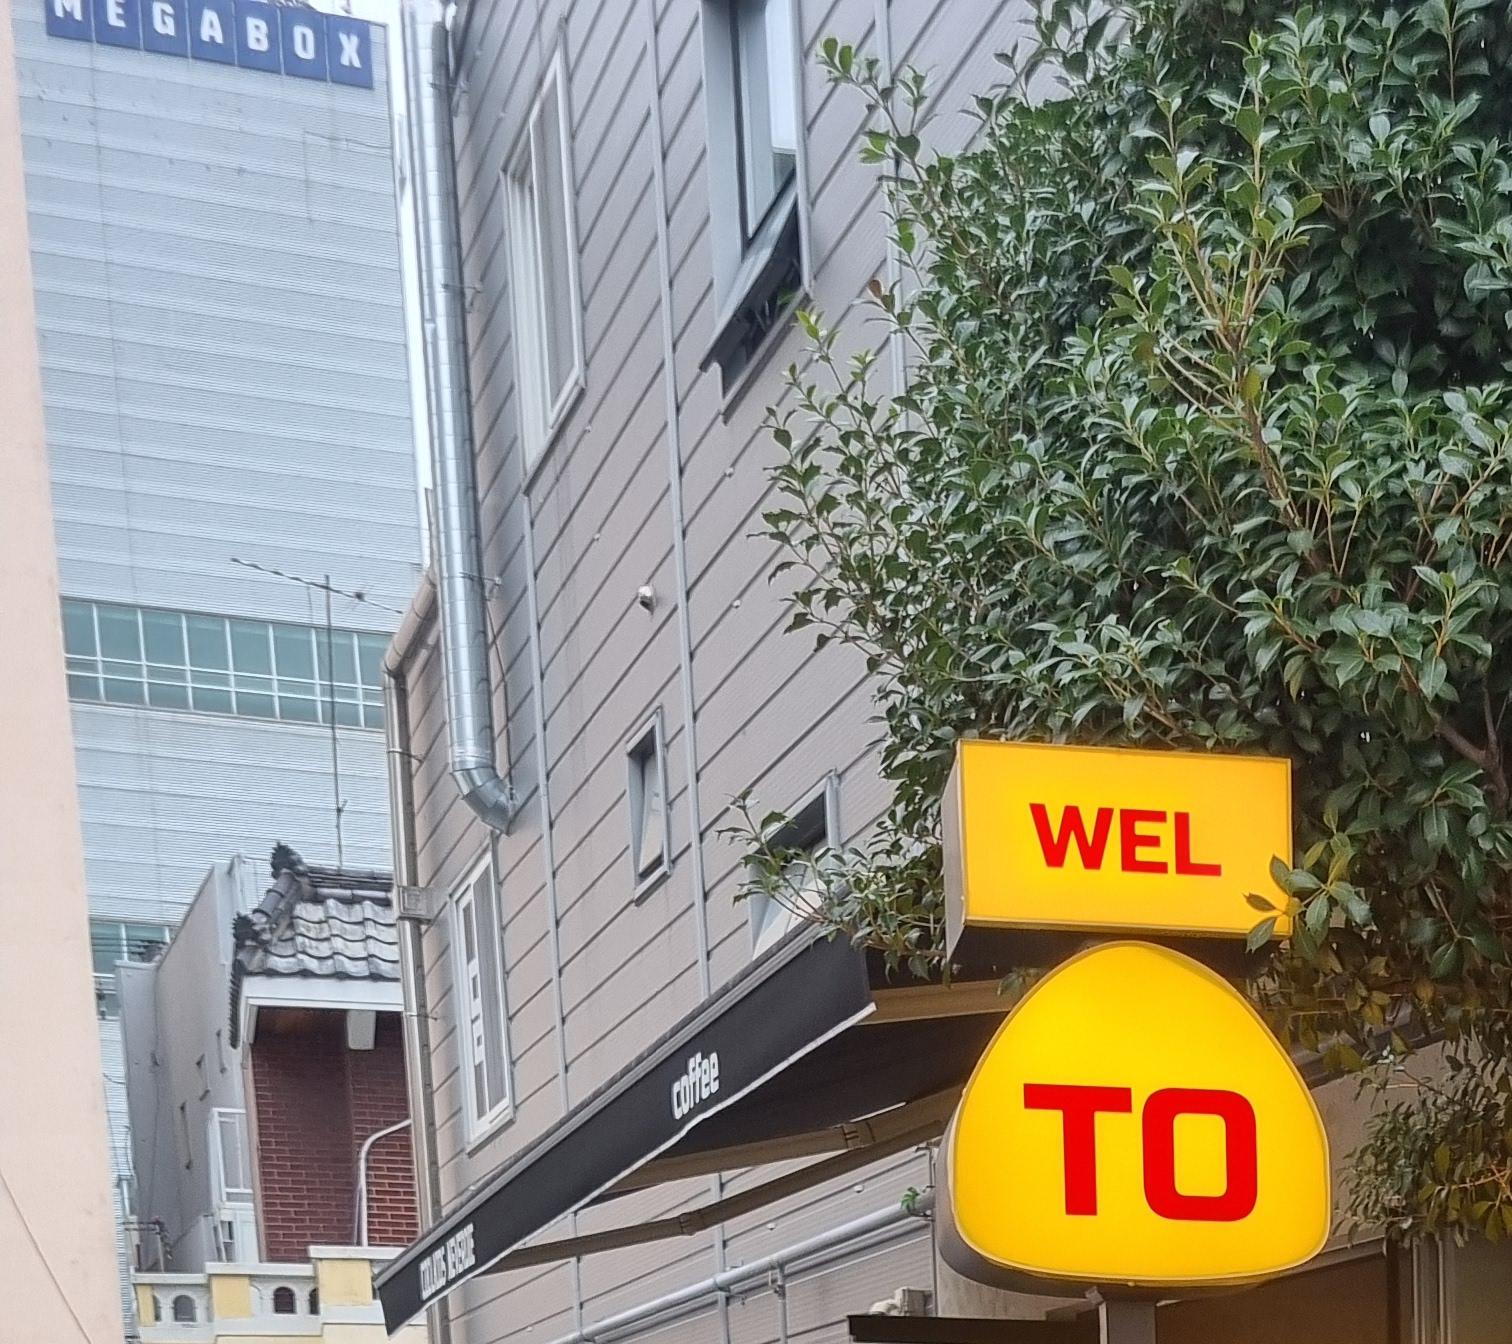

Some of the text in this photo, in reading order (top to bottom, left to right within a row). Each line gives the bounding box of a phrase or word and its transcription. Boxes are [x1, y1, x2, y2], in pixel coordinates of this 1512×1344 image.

[53, 0, 362, 69] MEGABOX
[1029, 803, 1221, 877] WEL
[673, 1052, 719, 1120] coffee
[1023, 1083, 1258, 1222] TO
